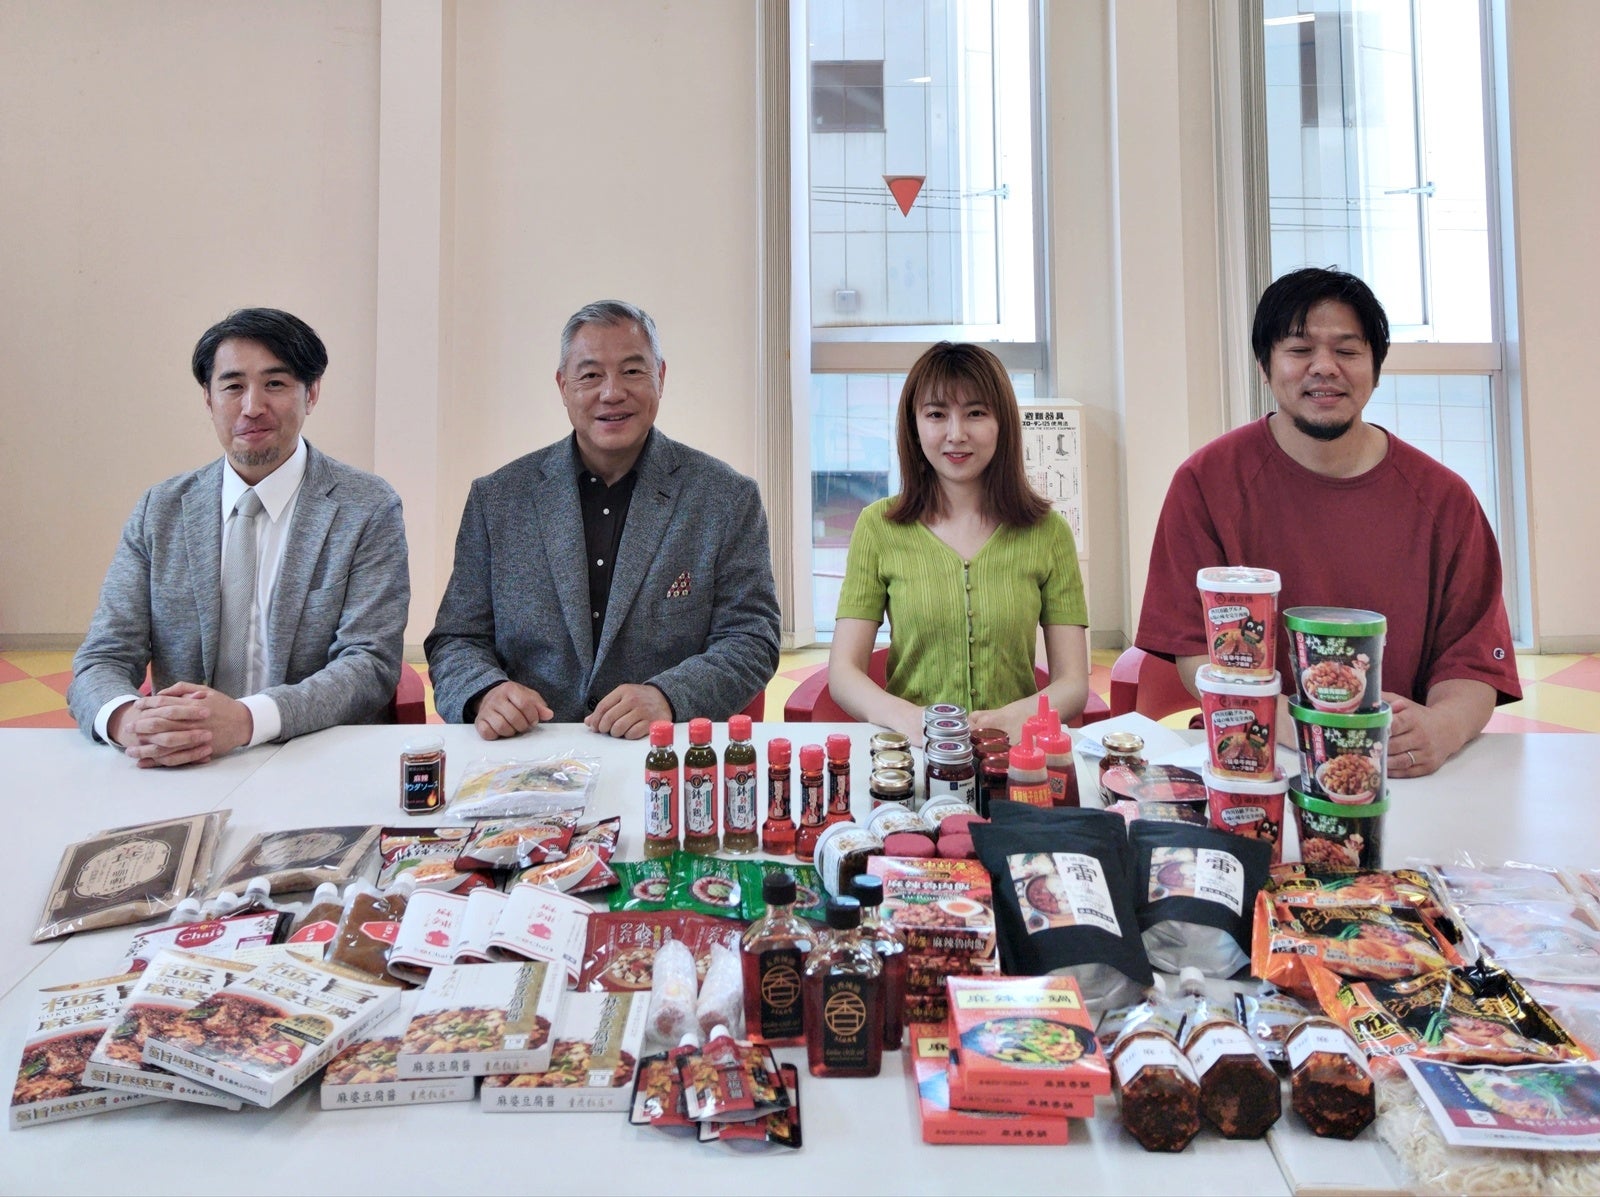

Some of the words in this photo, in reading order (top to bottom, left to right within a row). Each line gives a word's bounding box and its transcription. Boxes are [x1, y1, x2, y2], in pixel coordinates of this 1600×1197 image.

[1024, 411, 1064, 420] 避難器具
[413, 773, 428, 782] 麻辣
[619, 922, 633, 943] のたれ
[932, 937, 985, 950] 麻辣魯肉飯
[825, 991, 866, 1036] 香
[412, 1061, 471, 1073] 麻婆豆腐醤
[336, 1089, 396, 1104] 麻婆豆腐醤
[496, 1095, 556, 1108] 麻婆豆腐醤
